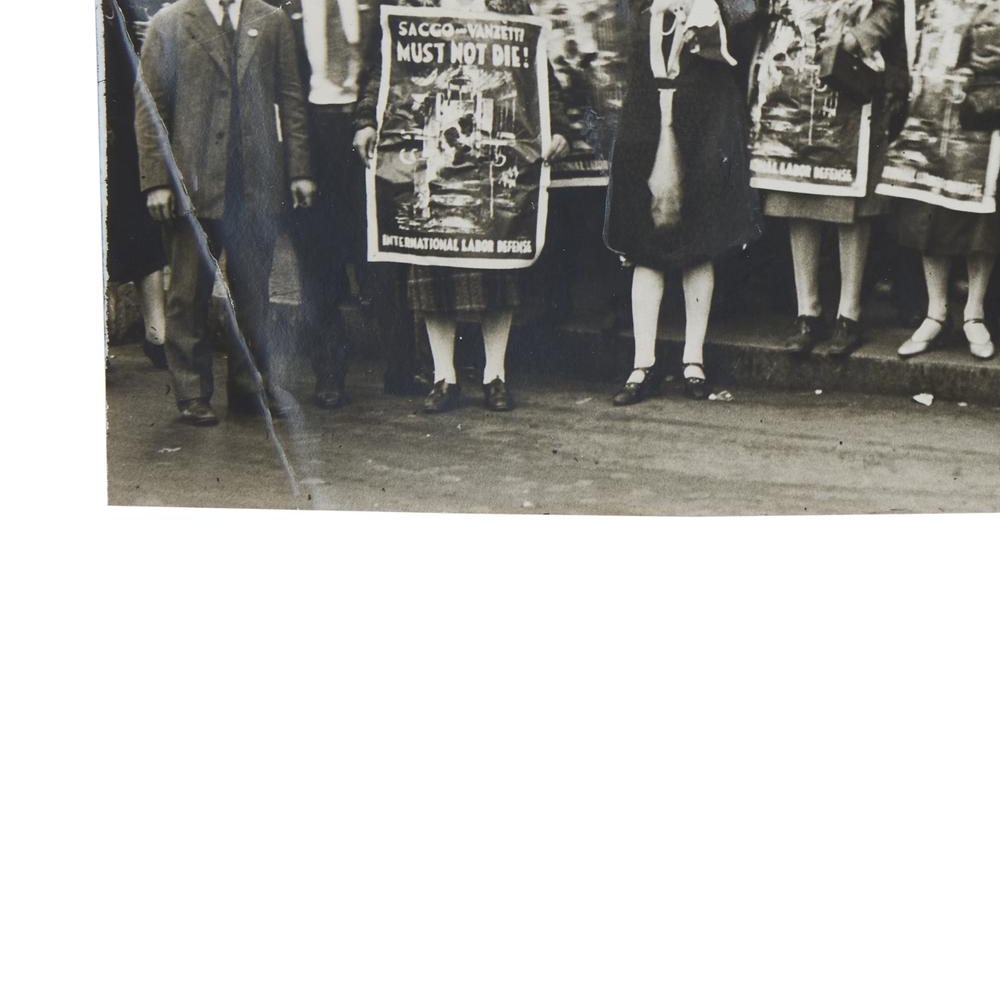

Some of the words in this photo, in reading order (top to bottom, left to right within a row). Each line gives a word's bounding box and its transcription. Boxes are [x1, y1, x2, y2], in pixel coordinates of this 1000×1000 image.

[397, 40, 446, 64] MUST
[451, 41, 487, 65] NOT
[492, 45, 530, 69] DIE!
[382, 233, 459, 252] INTERNATIONAL
[461, 239, 494, 253] LABOR
[497, 240, 532, 255] DEFENSE
